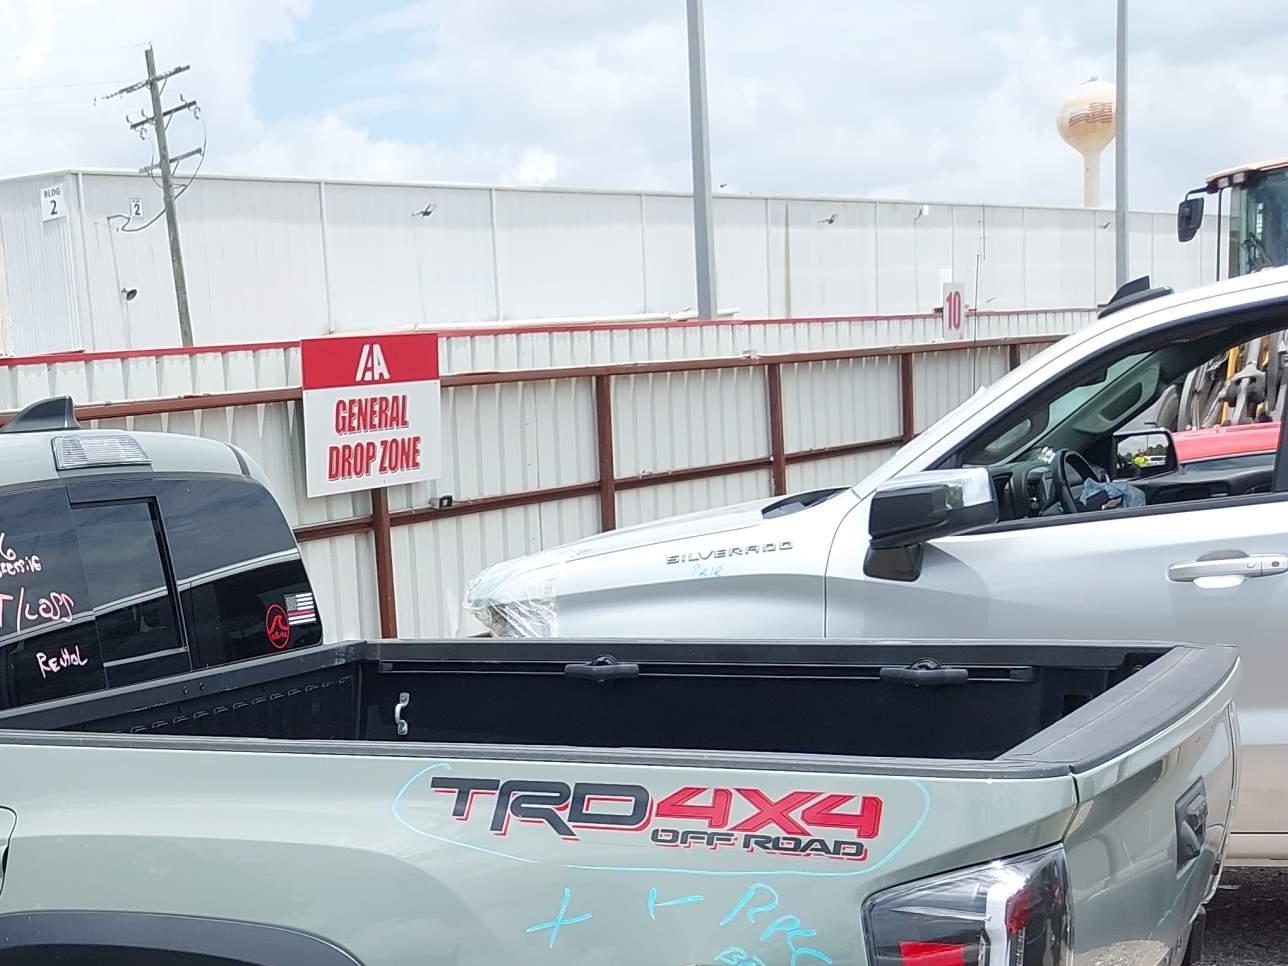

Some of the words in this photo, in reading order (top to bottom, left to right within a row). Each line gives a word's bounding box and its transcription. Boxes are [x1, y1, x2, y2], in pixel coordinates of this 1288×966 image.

[43, 186, 62, 199] BLDG
[50, 200, 59, 216] 2
[133, 203, 141, 216] 2
[946, 290, 961, 330] 10
[334, 394, 410, 436] GENERAL
[327, 442, 377, 481] DROP
[377, 436, 422, 475] ZONE
[666, 541, 794, 565] SILVERADO
[430, 776, 656, 841] TRD
[650, 828, 738, 852] OFF
[742, 833, 868, 862] ROAD
